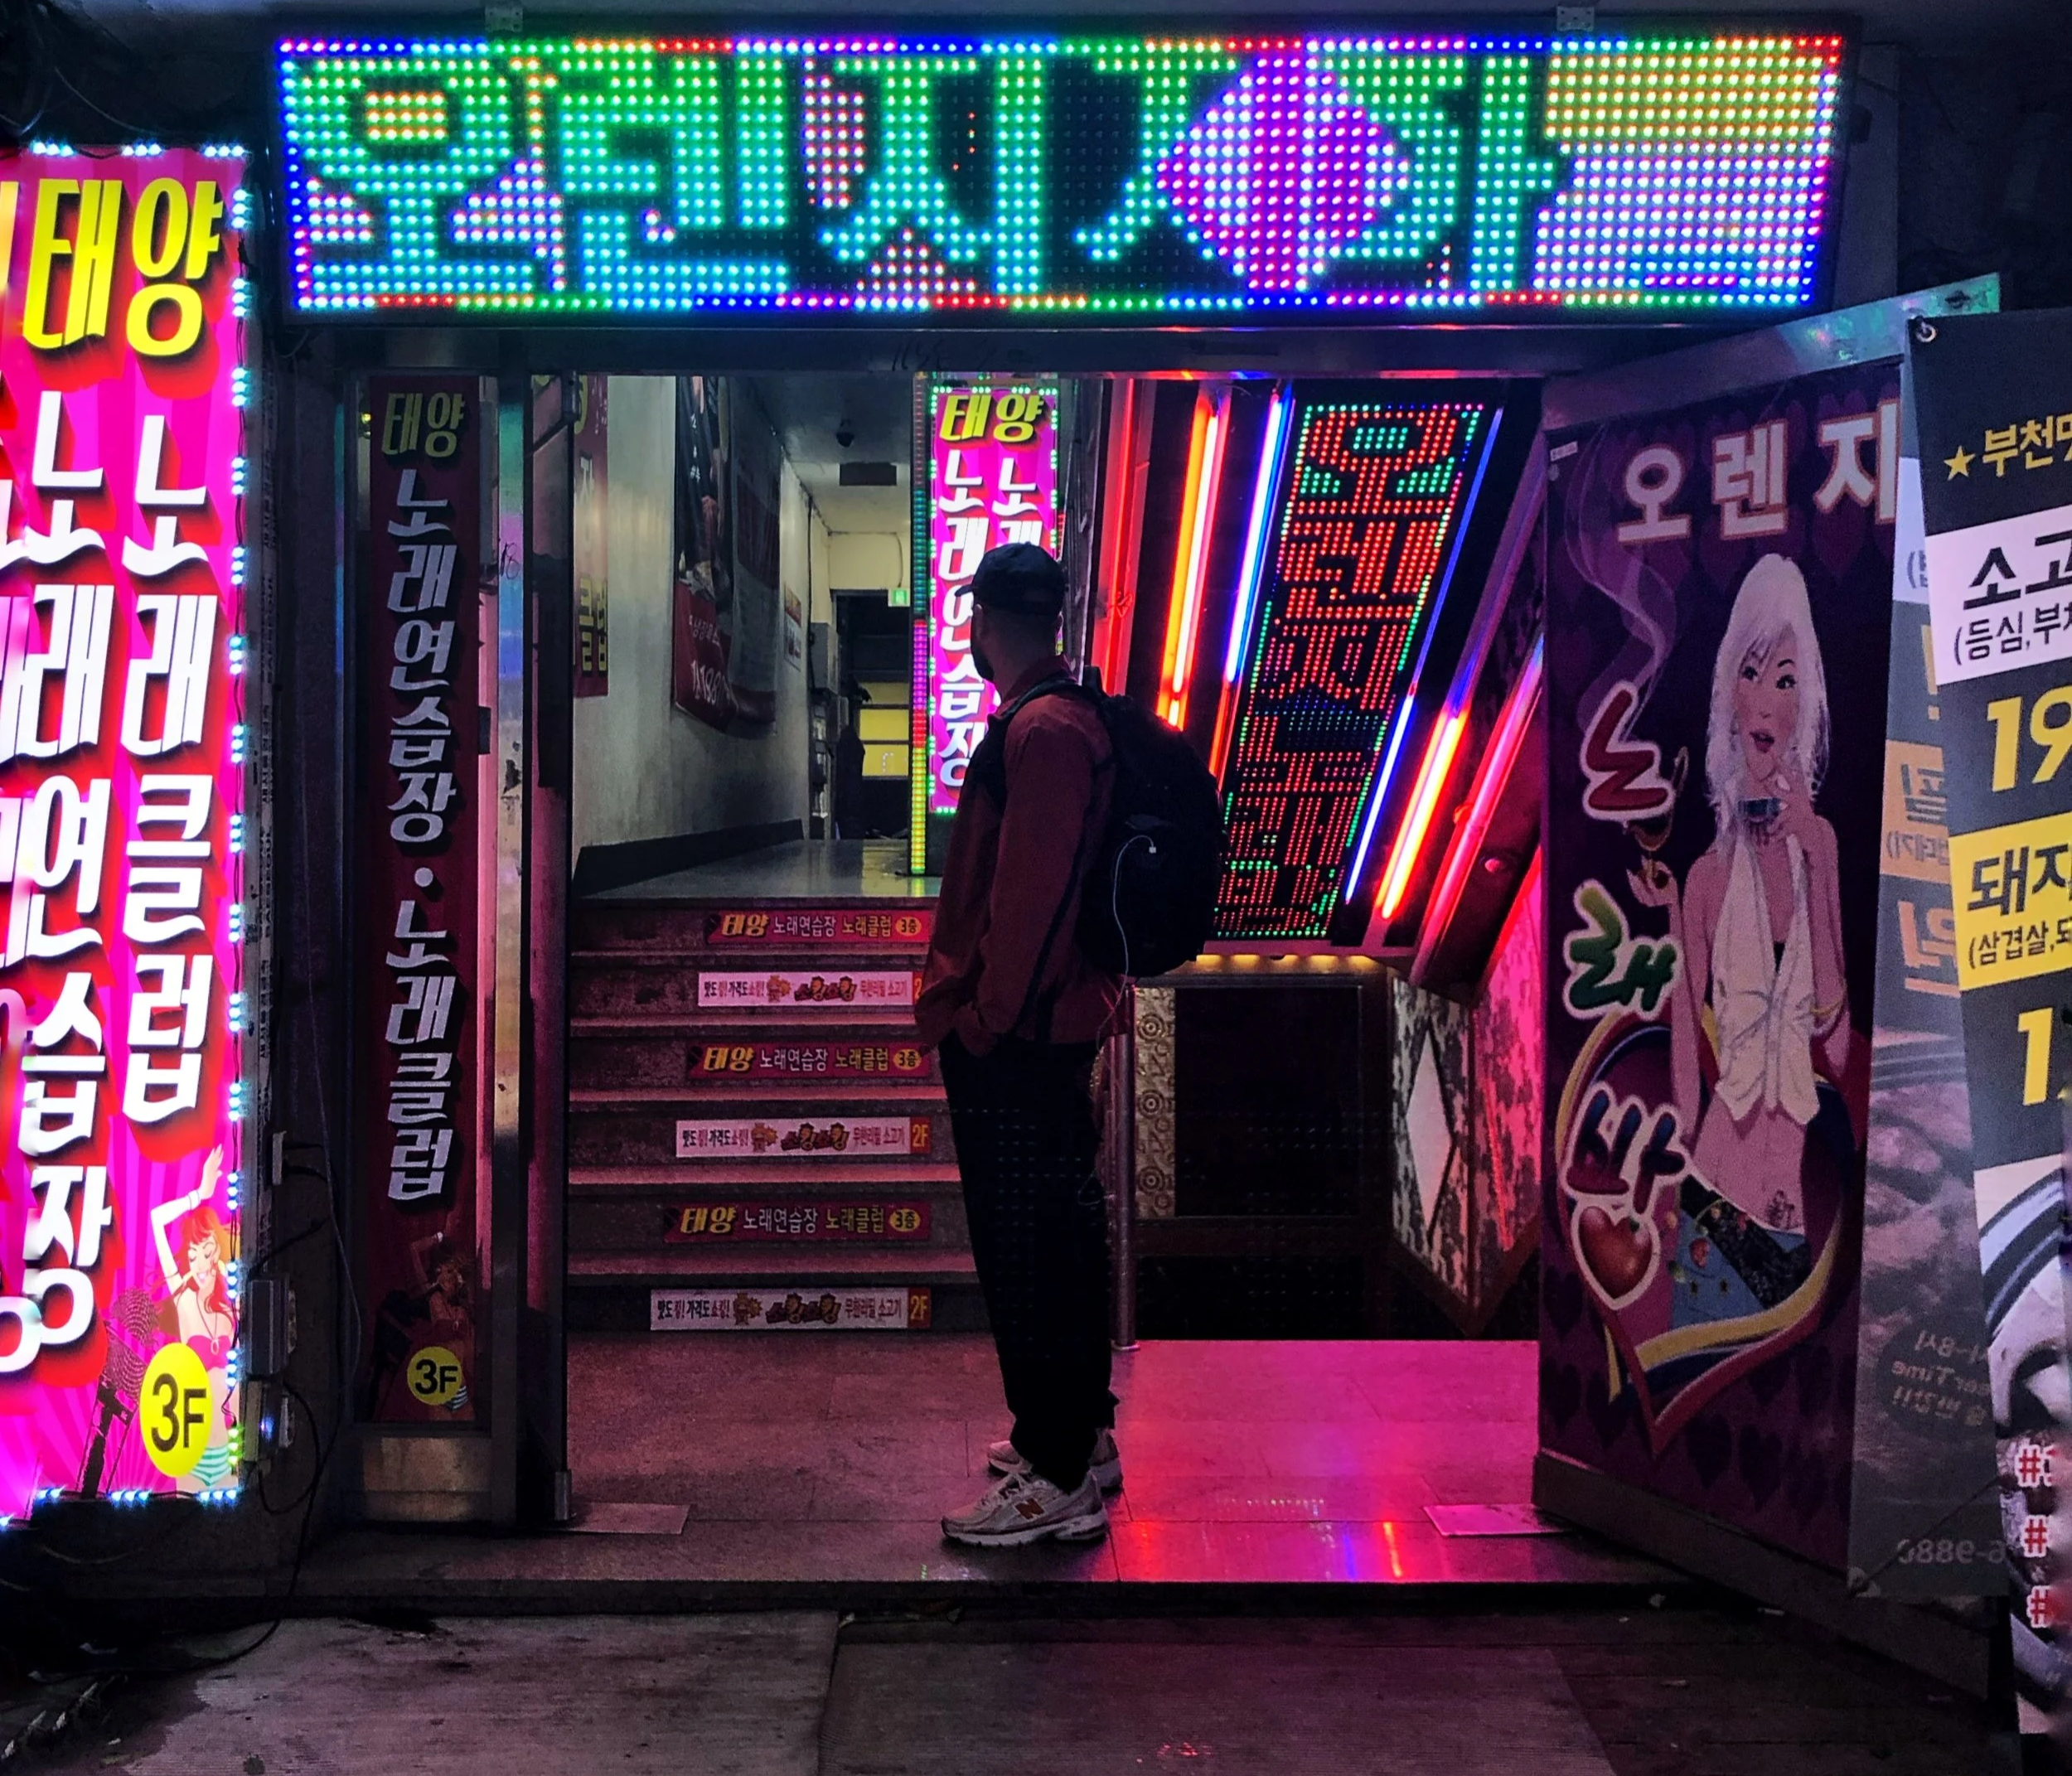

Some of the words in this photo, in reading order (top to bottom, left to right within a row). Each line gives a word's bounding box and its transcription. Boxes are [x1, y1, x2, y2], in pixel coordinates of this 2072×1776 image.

[22, 177, 224, 356] 태양
[380, 391, 466, 459] 태양
[938, 394, 1045, 442] 태양
[1615, 398, 1900, 544] 오렌지
[120, 414, 217, 1124] 노래클럽
[12, 390, 116, 1346] 노래연습장
[720, 913, 770, 937] 태양
[772, 915, 836, 937] 노래연습장
[841, 915, 893, 938] 노래클럽
[704, 1047, 755, 1072] 태양
[759, 1048, 829, 1071] 노래연습장
[835, 1048, 889, 1072] 노래클럽
[912, 1124, 929, 1148] 2F
[680, 1206, 737, 1234] 태양
[743, 1207, 818, 1234] 노래연습장
[825, 1207, 884, 1233] 노래클럽
[910, 1294, 927, 1321] 2F
[414, 1358, 459, 1396] 3F
[150, 1372, 207, 1453] 3F
